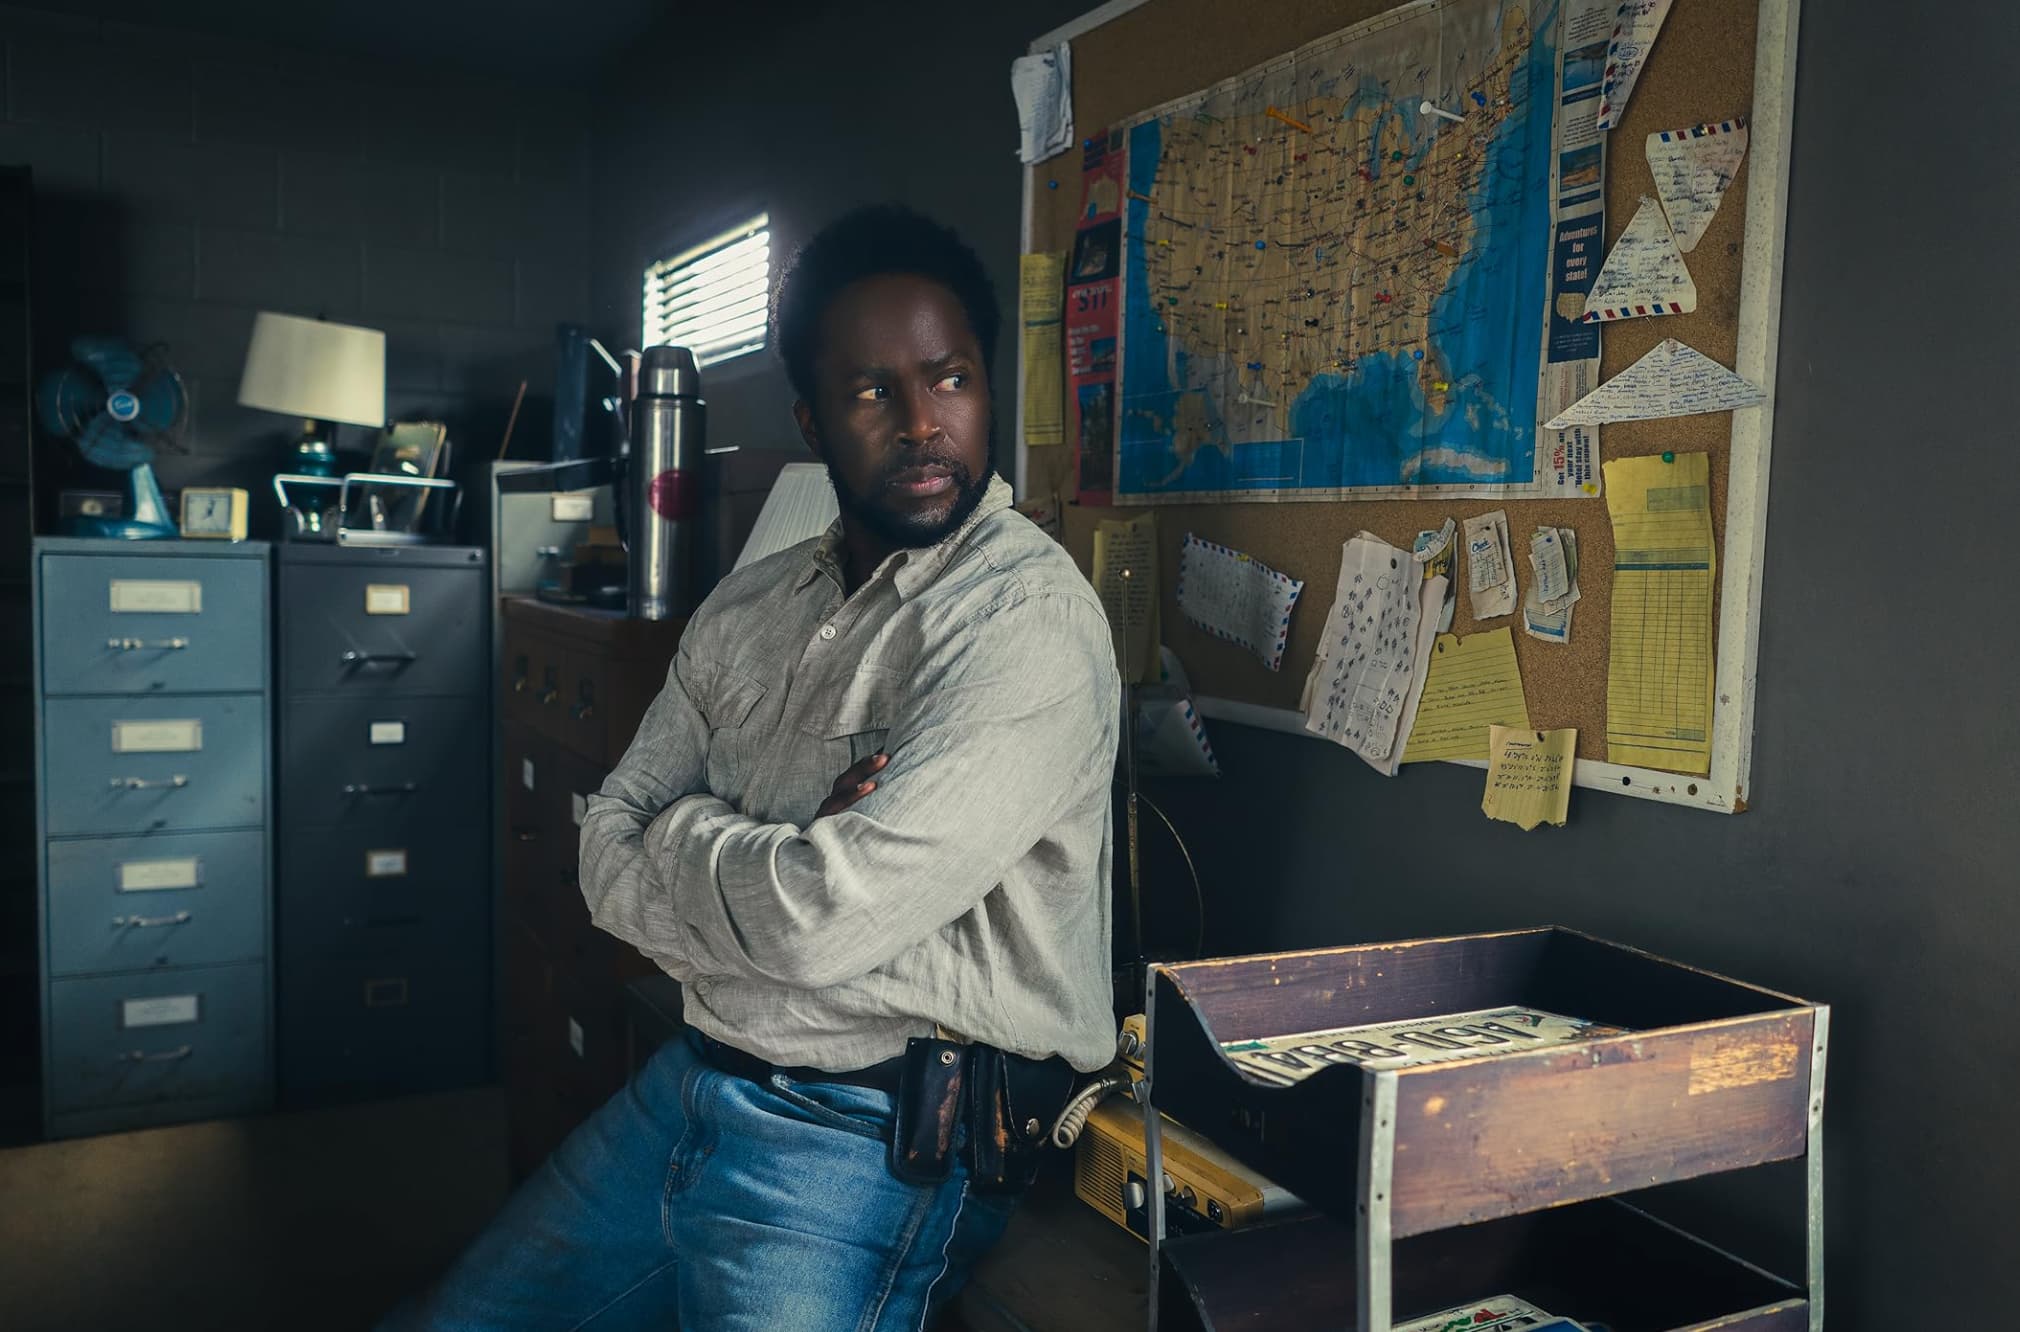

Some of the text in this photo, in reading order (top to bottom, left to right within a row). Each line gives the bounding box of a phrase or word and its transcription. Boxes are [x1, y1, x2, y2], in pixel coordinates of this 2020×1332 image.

[1559, 225, 1598, 242] Adventures
[1572, 242, 1584, 253] for
[1566, 256, 1588, 268] every
[1565, 267, 1588, 282] state!
[1553, 444, 1565, 470] 15%
